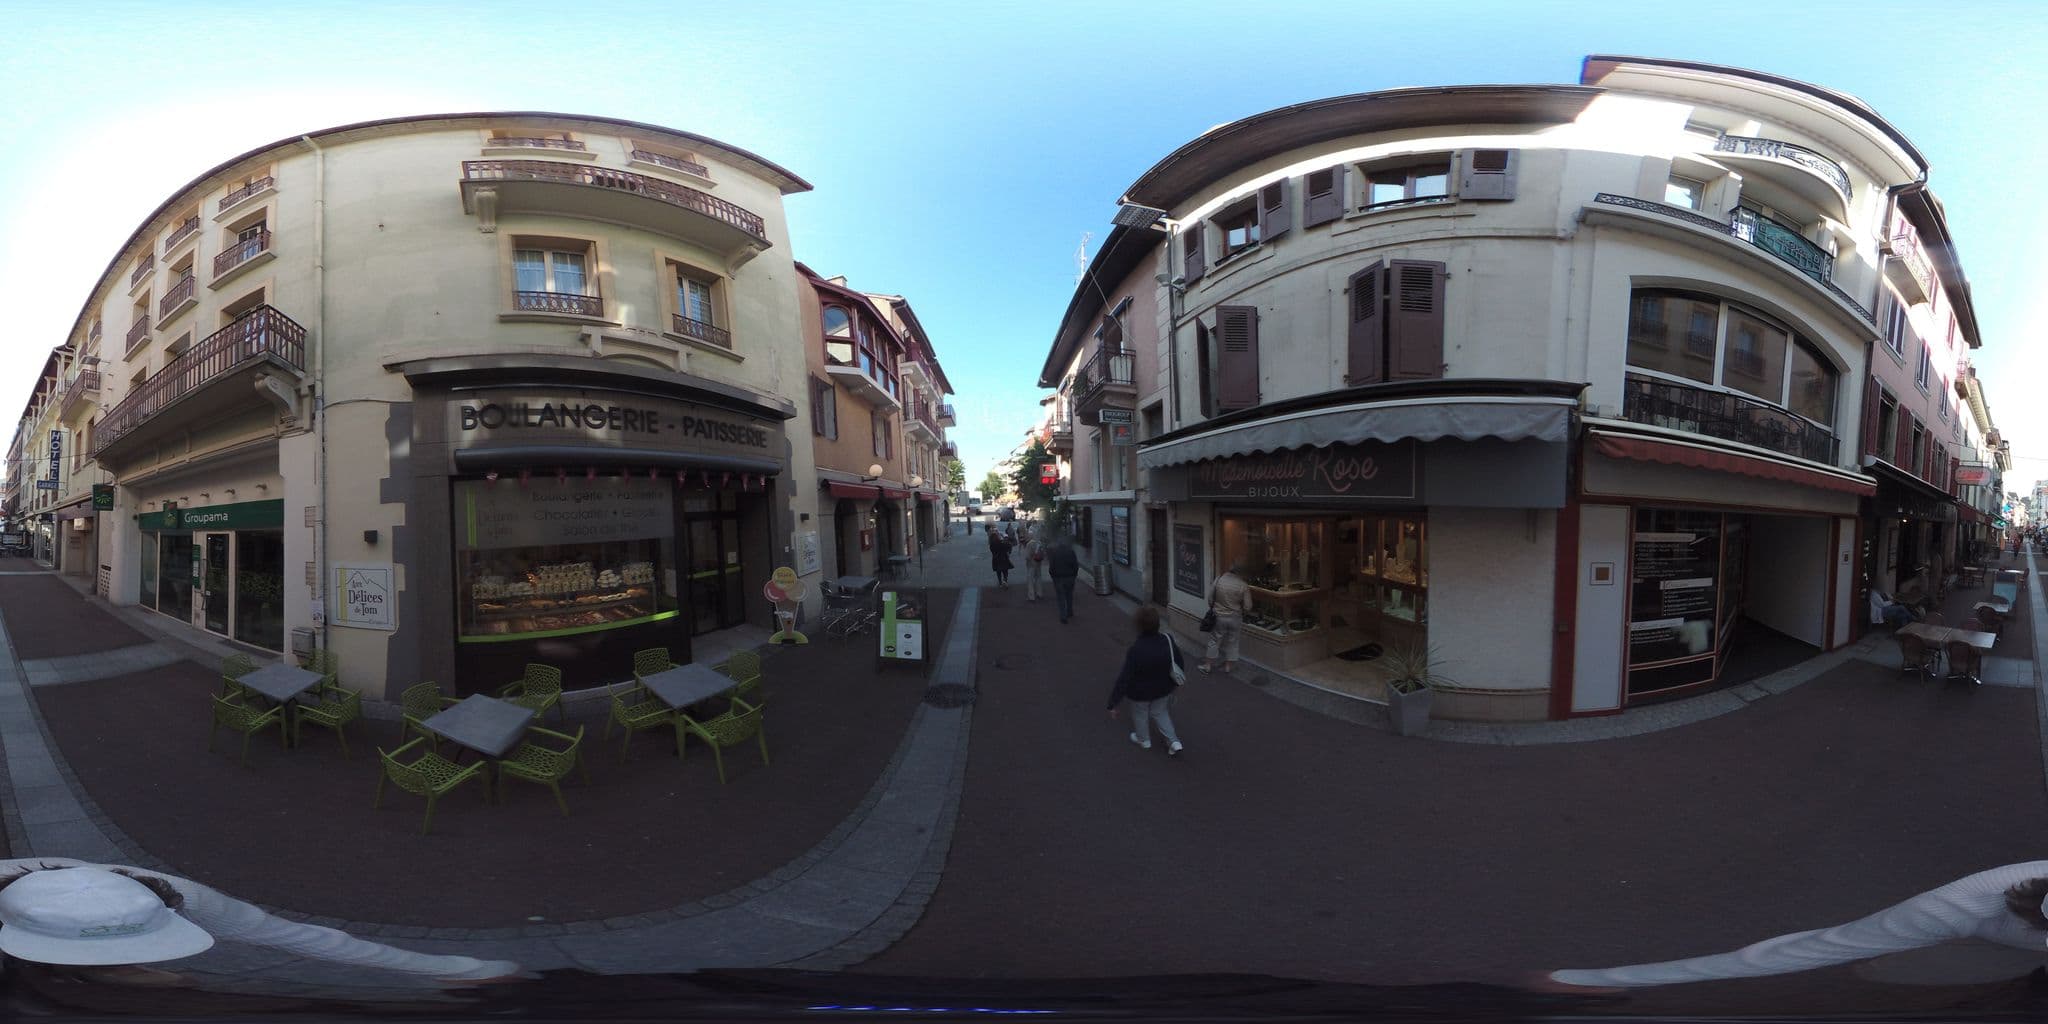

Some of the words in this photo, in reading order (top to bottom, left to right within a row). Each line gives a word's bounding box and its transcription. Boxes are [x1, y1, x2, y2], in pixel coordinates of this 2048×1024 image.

[461, 403, 658, 433] BOULANGERIE
[683, 416, 767, 448] PATISSERIE
[51, 431, 61, 480] HOTEL
[1309, 447, 1378, 492] Rose
[1248, 486, 1300, 498] BIJOUX
[184, 512, 229, 524] Groupama
[348, 590, 383, 604] Délices
[360, 603, 378, 615] Tom
